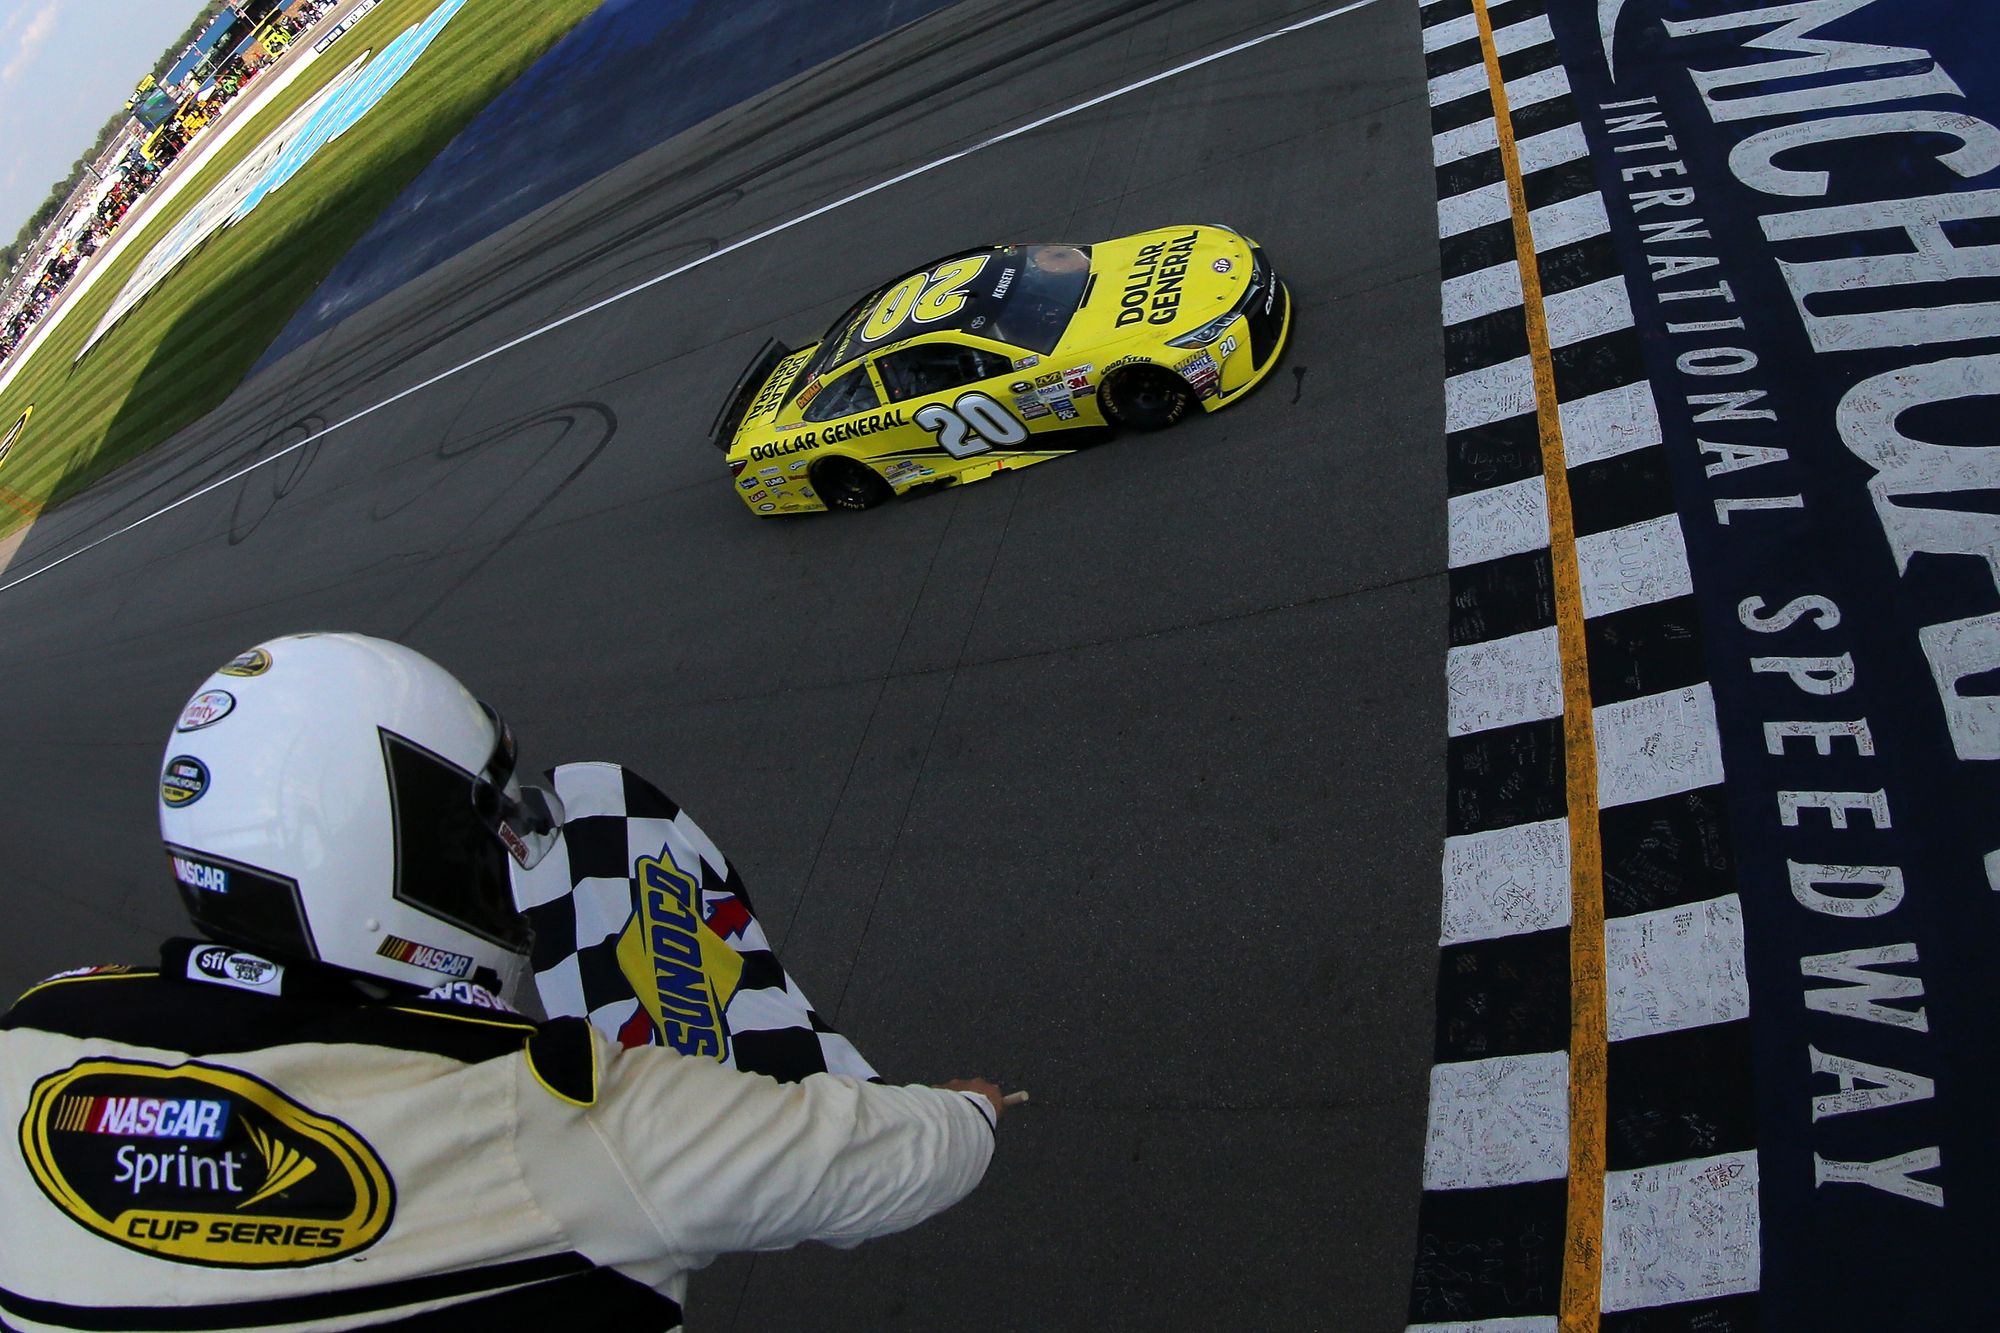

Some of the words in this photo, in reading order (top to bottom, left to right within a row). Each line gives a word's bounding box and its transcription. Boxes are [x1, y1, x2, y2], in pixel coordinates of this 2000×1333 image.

[991, 267, 1016, 300] KENSETH
[1115, 239, 1167, 328] DOLLAR
[1148, 230, 1199, 326] GENERAL
[1213, 258, 1231, 273] STP
[861, 254, 992, 343] 20
[1182, 355, 1212, 376] MAHLE
[1219, 335, 1237, 358] 20
[743, 357, 789, 427] GENERAL
[761, 355, 808, 417] DOLLAR
[1066, 377, 1089, 390] 3M
[751, 432, 819, 462] DOLLAR
[822, 410, 910, 445] GENERAL
[913, 393, 1028, 460] 20
[1660, 0, 2000, 893] MICHI
[1599, 95, 1804, 525] INTERNATIONAL
[1738, 594, 1944, 1208] SPEEDWAY
[173, 856, 226, 893] NASCAR
[201, 951, 226, 971] sfi
[411, 943, 473, 977] NASCAR
[646, 863, 719, 1056] SUNOCO
[97, 1096, 223, 1139] NASCAR
[114, 1145, 244, 1194] Sprint
[128, 1217, 199, 1240] CUP
[206, 1221, 345, 1249] SERIES
